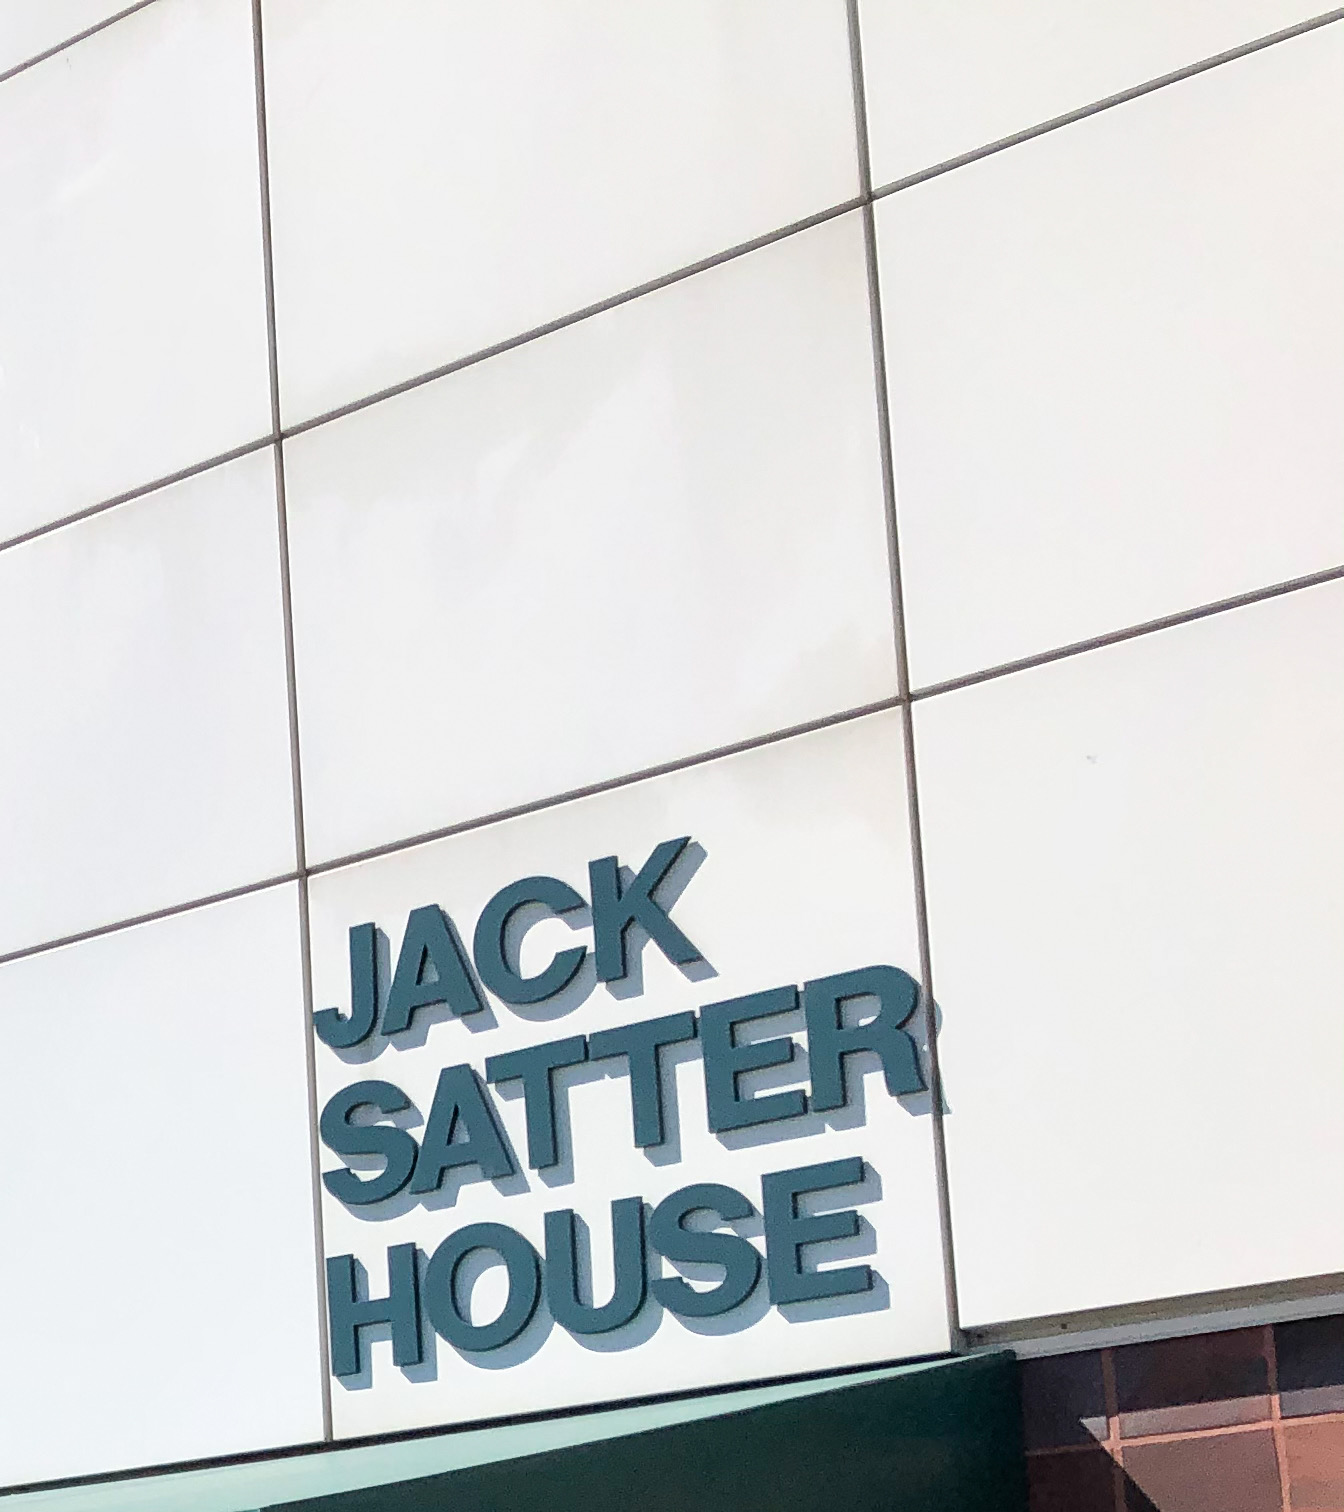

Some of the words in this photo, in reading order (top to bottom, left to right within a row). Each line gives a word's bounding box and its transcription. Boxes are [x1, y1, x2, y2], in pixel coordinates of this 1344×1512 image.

[313, 836, 704, 1050] JACK
[319, 965, 930, 1205] SATTER
[326, 1156, 874, 1377] HOUSE
